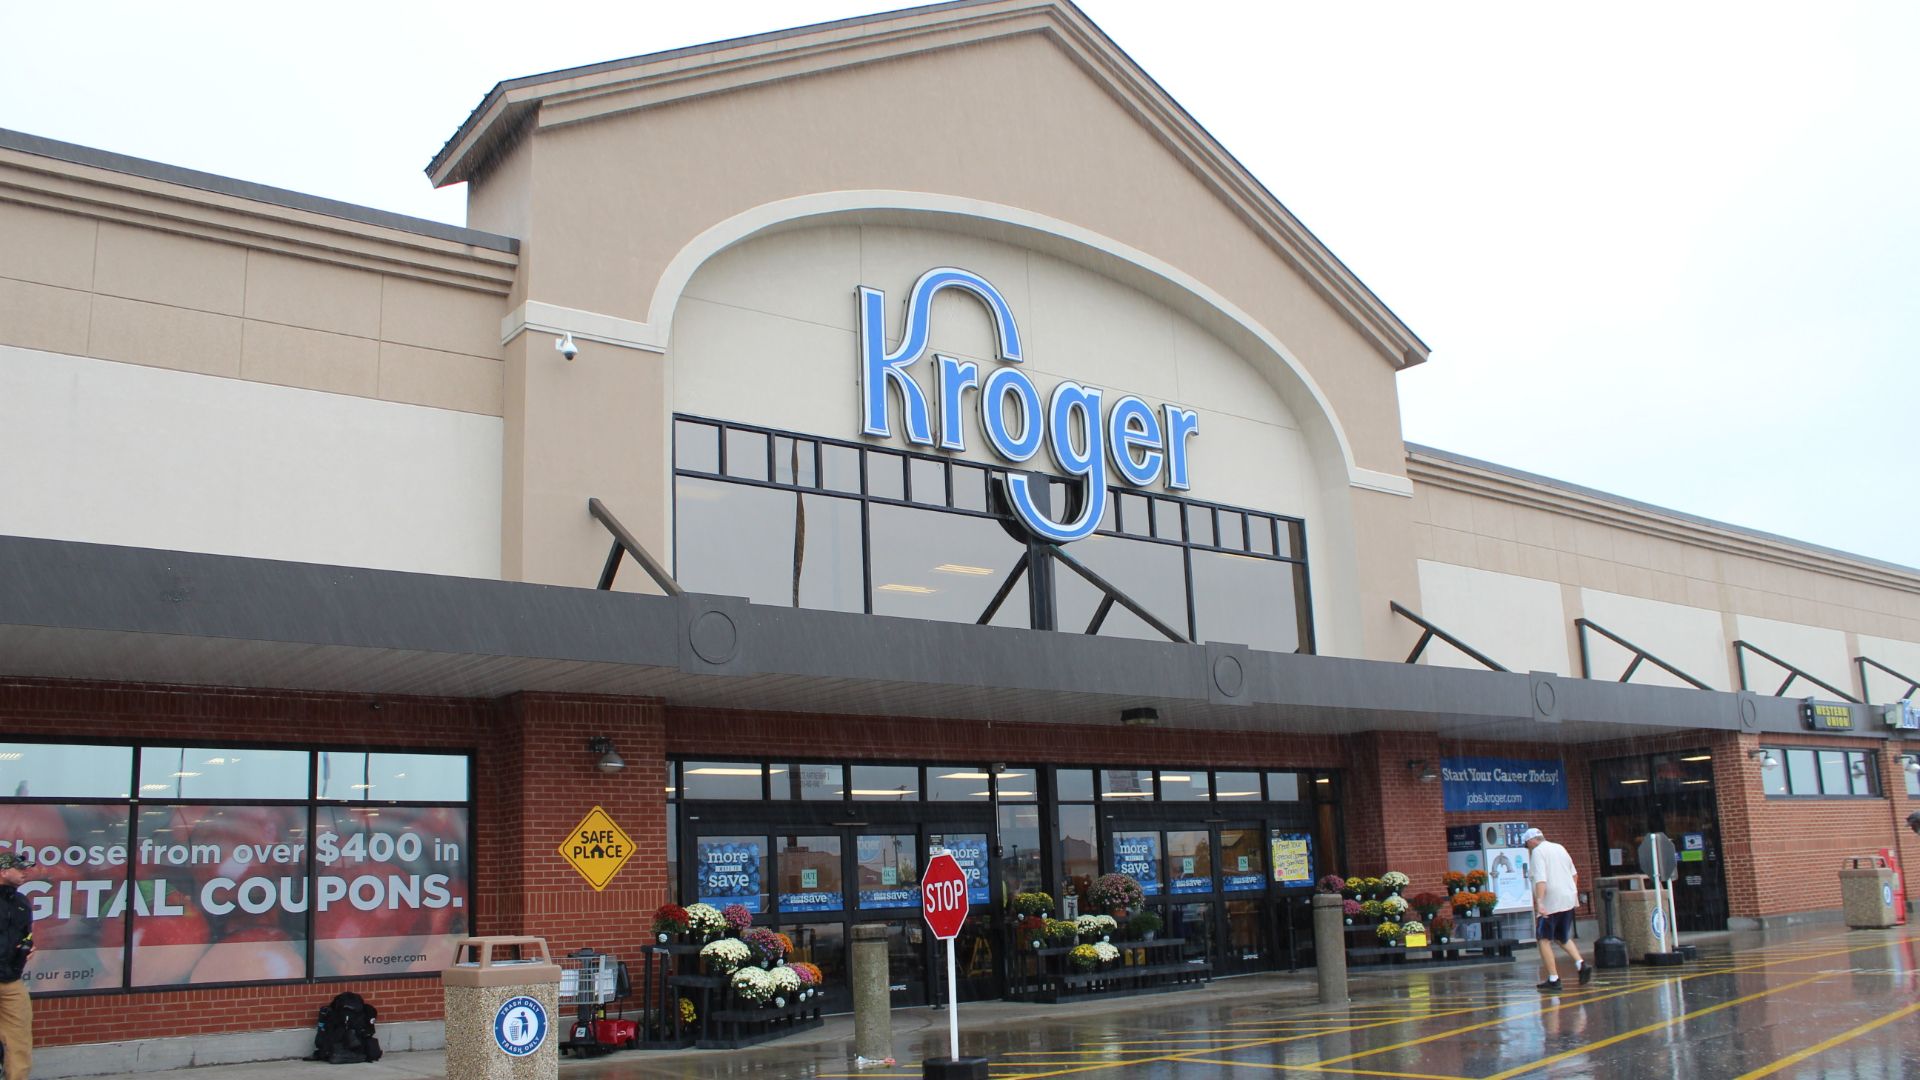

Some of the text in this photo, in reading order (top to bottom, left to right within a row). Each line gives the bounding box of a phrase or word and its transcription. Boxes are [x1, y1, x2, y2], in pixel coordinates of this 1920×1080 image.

[855, 266, 1199, 543] Kroger
[1442, 768, 1559, 785] Start Your Career Today!
[1467, 792, 1522, 806] jobs.kroger.com
[581, 831, 613, 844] SAFE
[140, 839, 221, 865] from
[233, 843, 304, 865] over
[315, 831, 422, 866] $400
[434, 838, 459, 862] in
[1119, 844, 1148, 854] more
[707, 852, 749, 863] more
[964, 868, 980, 879] ve
[1121, 863, 1149, 874] save
[709, 874, 749, 887] save
[17, 873, 463, 920] GITAL COUPONS.
[803, 894, 827, 903] save
[886, 891, 908, 900] save
[926, 880, 964, 913] STOP
[363, 953, 427, 965] Kroger.com
[36, 971, 59, 981] our
[63, 968, 95, 980] app!
[501, 1000, 540, 1016] TRASH ONLY
[502, 1036, 540, 1053] TRASH ONLY
